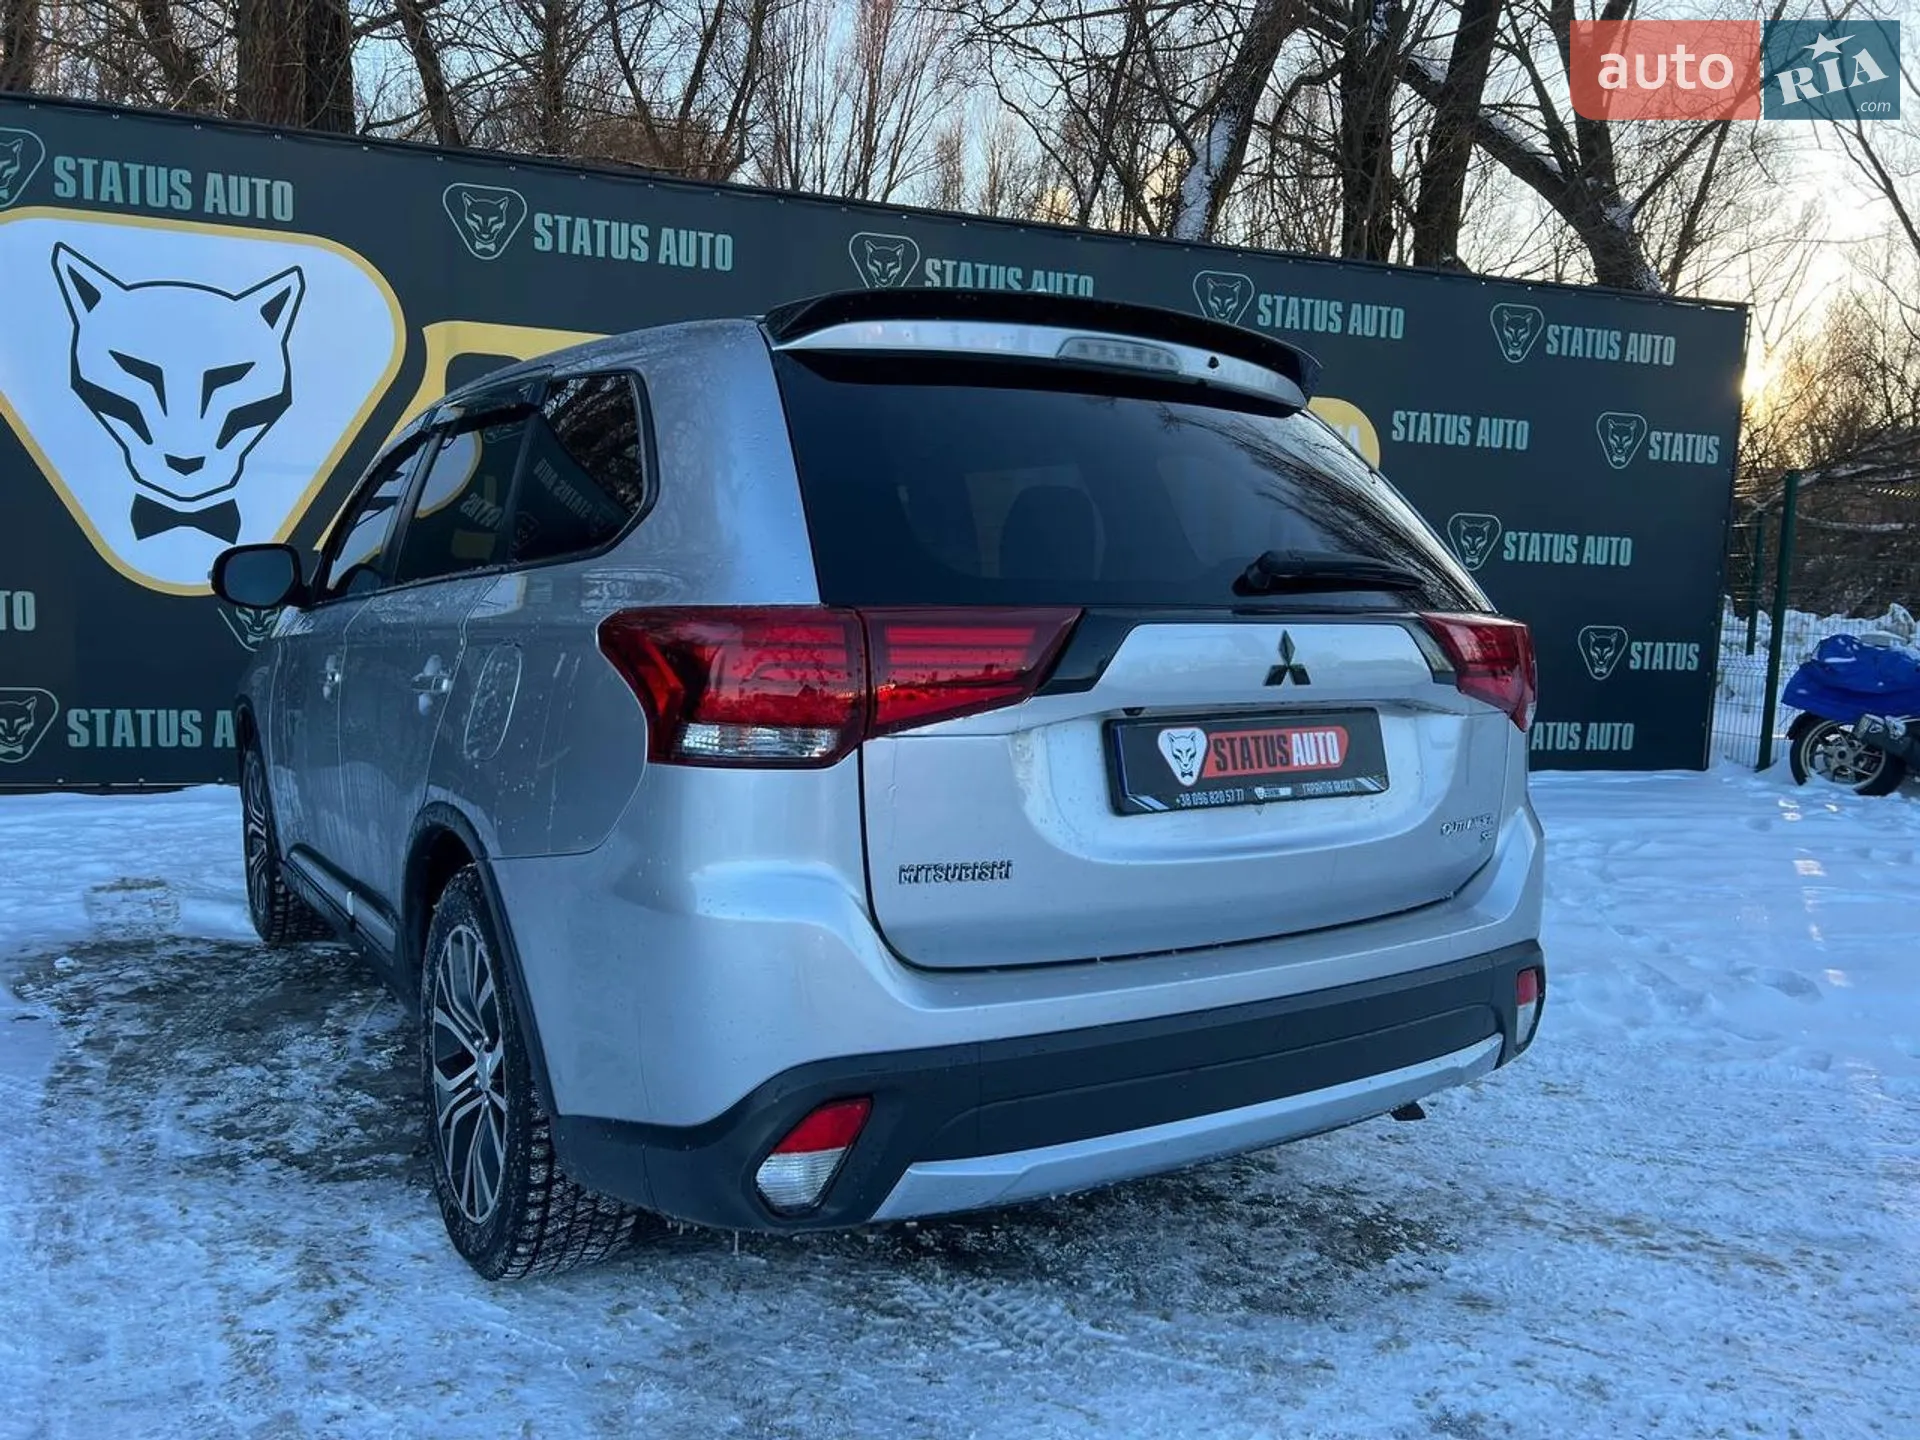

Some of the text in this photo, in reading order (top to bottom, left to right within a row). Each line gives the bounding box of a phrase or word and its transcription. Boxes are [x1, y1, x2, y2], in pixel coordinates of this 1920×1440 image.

[53, 155, 295, 223] STATUS AUTO
[534, 212, 733, 272] STATUS AUTO
[924, 257, 1094, 298] STATUS AUTO
[1256, 293, 1405, 340] STATUS AUTO
[1546, 324, 1676, 366] STATUS AUTO
[1391, 410, 1472, 446] STATUS
[1477, 416, 1529, 450] AUTO
[1648, 431, 1720, 464] STATUS
[1503, 531, 1632, 567] STATUS AUTO
[0, 590, 36, 631] TO
[1629, 640, 1700, 671] STATUS
[66, 708, 203, 748] STATUS
[1531, 721, 1635, 751] ATUS AUTO
[899, 860, 1013, 885] MITSUBISHI
